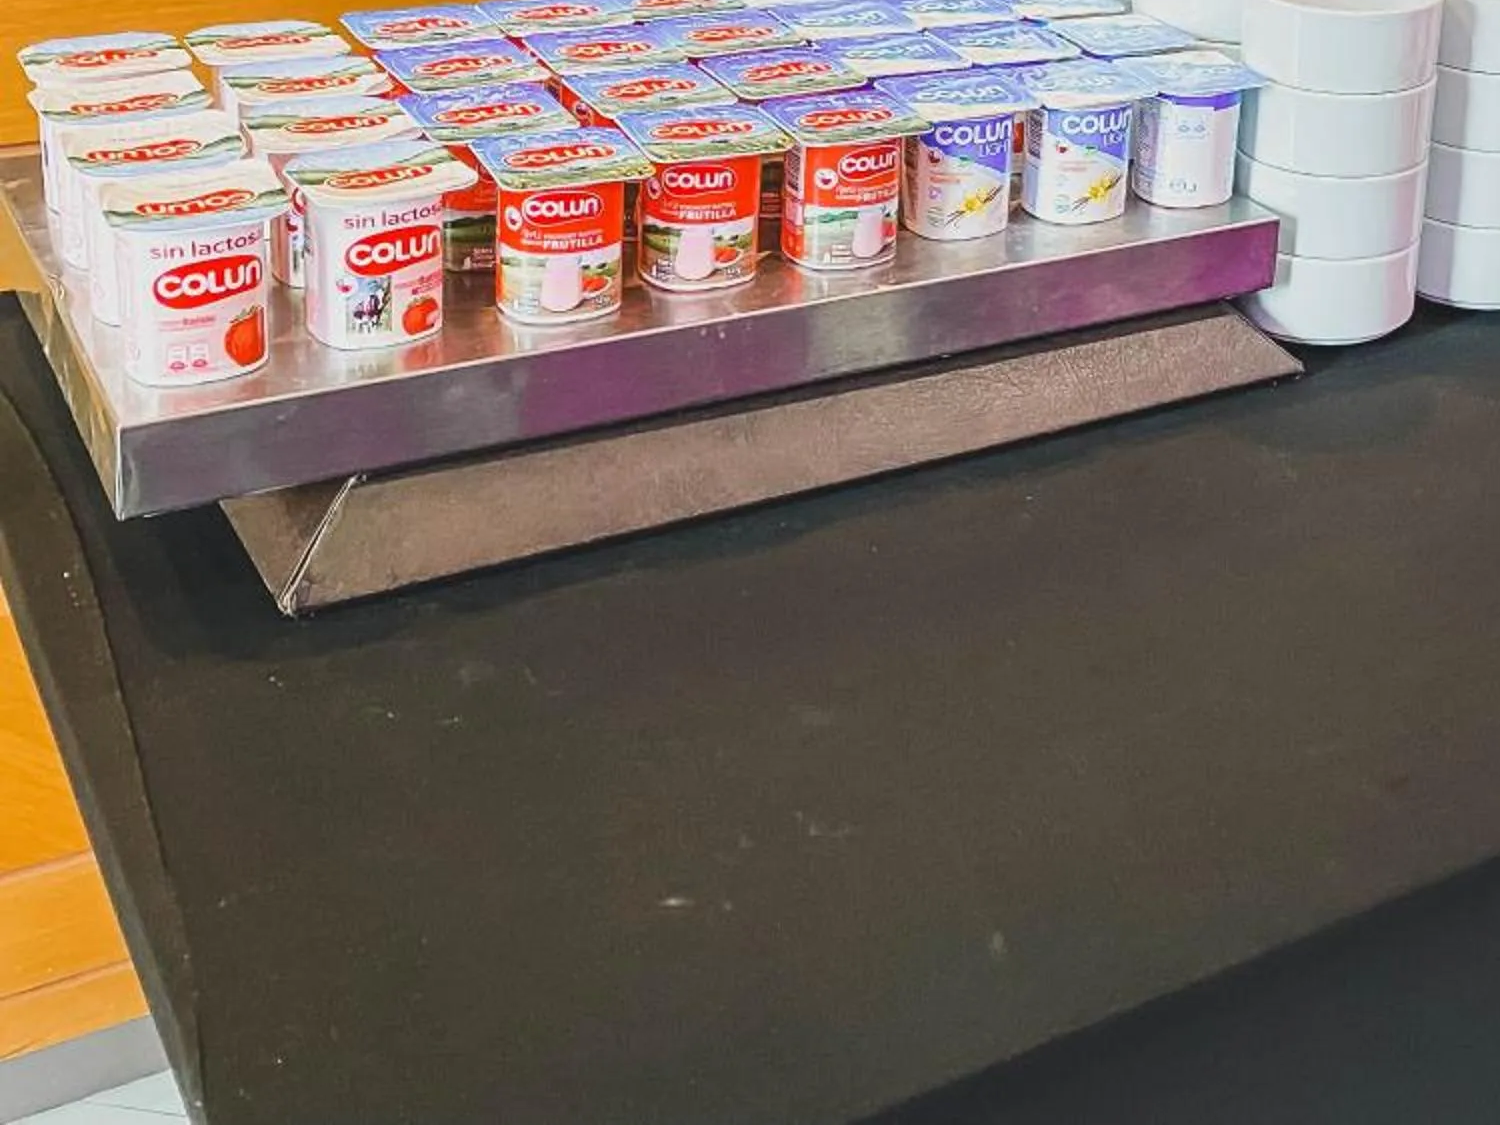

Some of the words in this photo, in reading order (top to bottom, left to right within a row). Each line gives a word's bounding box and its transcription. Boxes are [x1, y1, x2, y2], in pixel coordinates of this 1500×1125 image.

[935, 118, 1012, 145] COLUN
[506, 144, 613, 165] COLUN
[979, 139, 1011, 158] LIGH
[330, 166, 431, 187] COLUN
[665, 171, 732, 189] COLUN
[344, 212, 376, 229] sin
[382, 202, 441, 226] lactos
[525, 197, 598, 217] COLUN
[150, 244, 184, 260] sin
[191, 230, 261, 256] lactos
[349, 226, 441, 266] COLUN
[156, 260, 263, 299] COLUN
